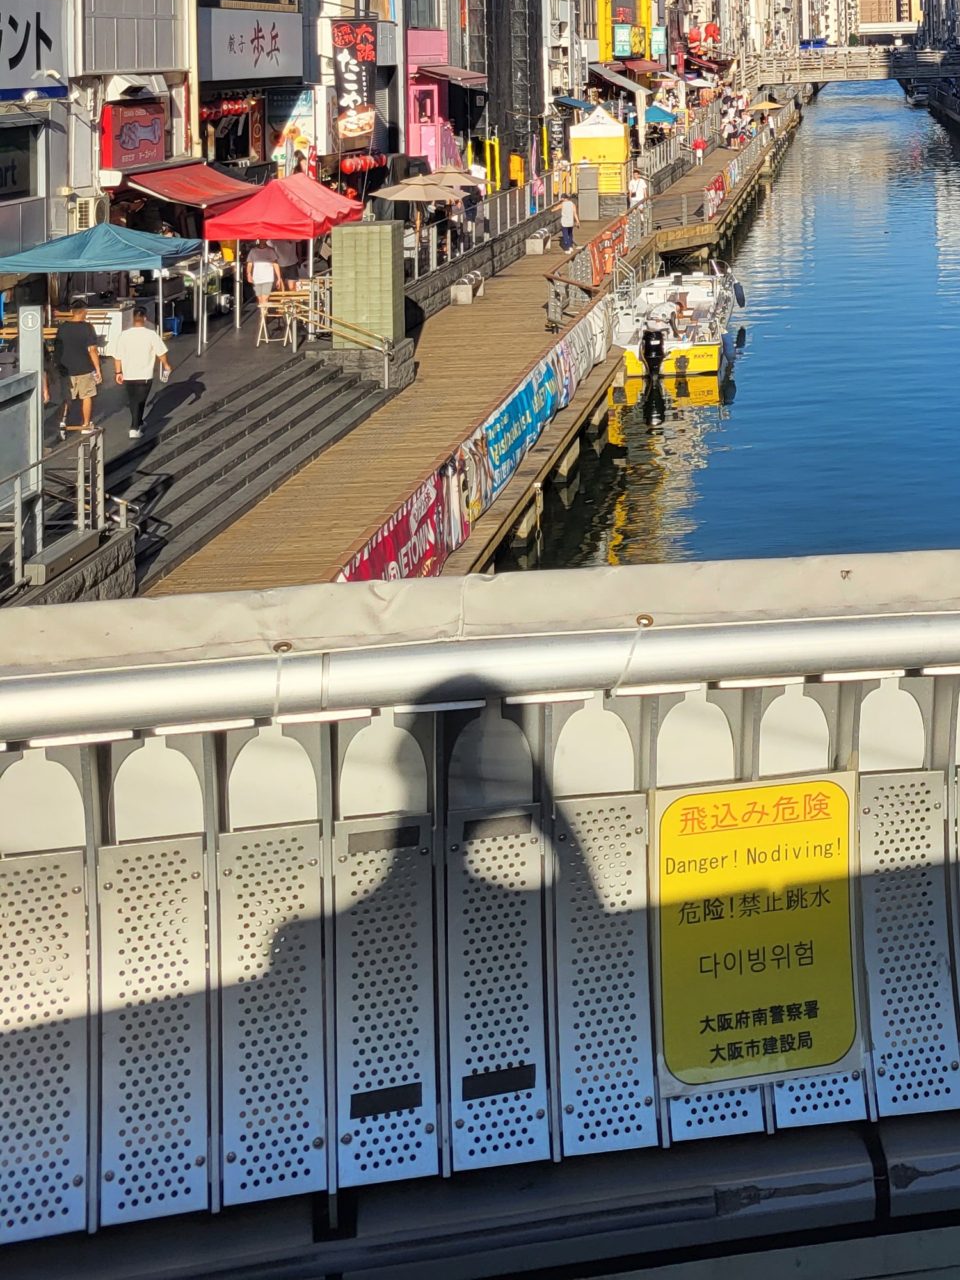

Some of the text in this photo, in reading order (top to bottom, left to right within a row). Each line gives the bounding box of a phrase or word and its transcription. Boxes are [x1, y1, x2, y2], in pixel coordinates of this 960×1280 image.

[679, 792, 832, 834] 飛込み危険
[699, 940, 815, 980] 다이빙위험
[700, 1000, 820, 1035] 大阪府南警察署
[709, 1031, 813, 1063] 大阪市建設局
